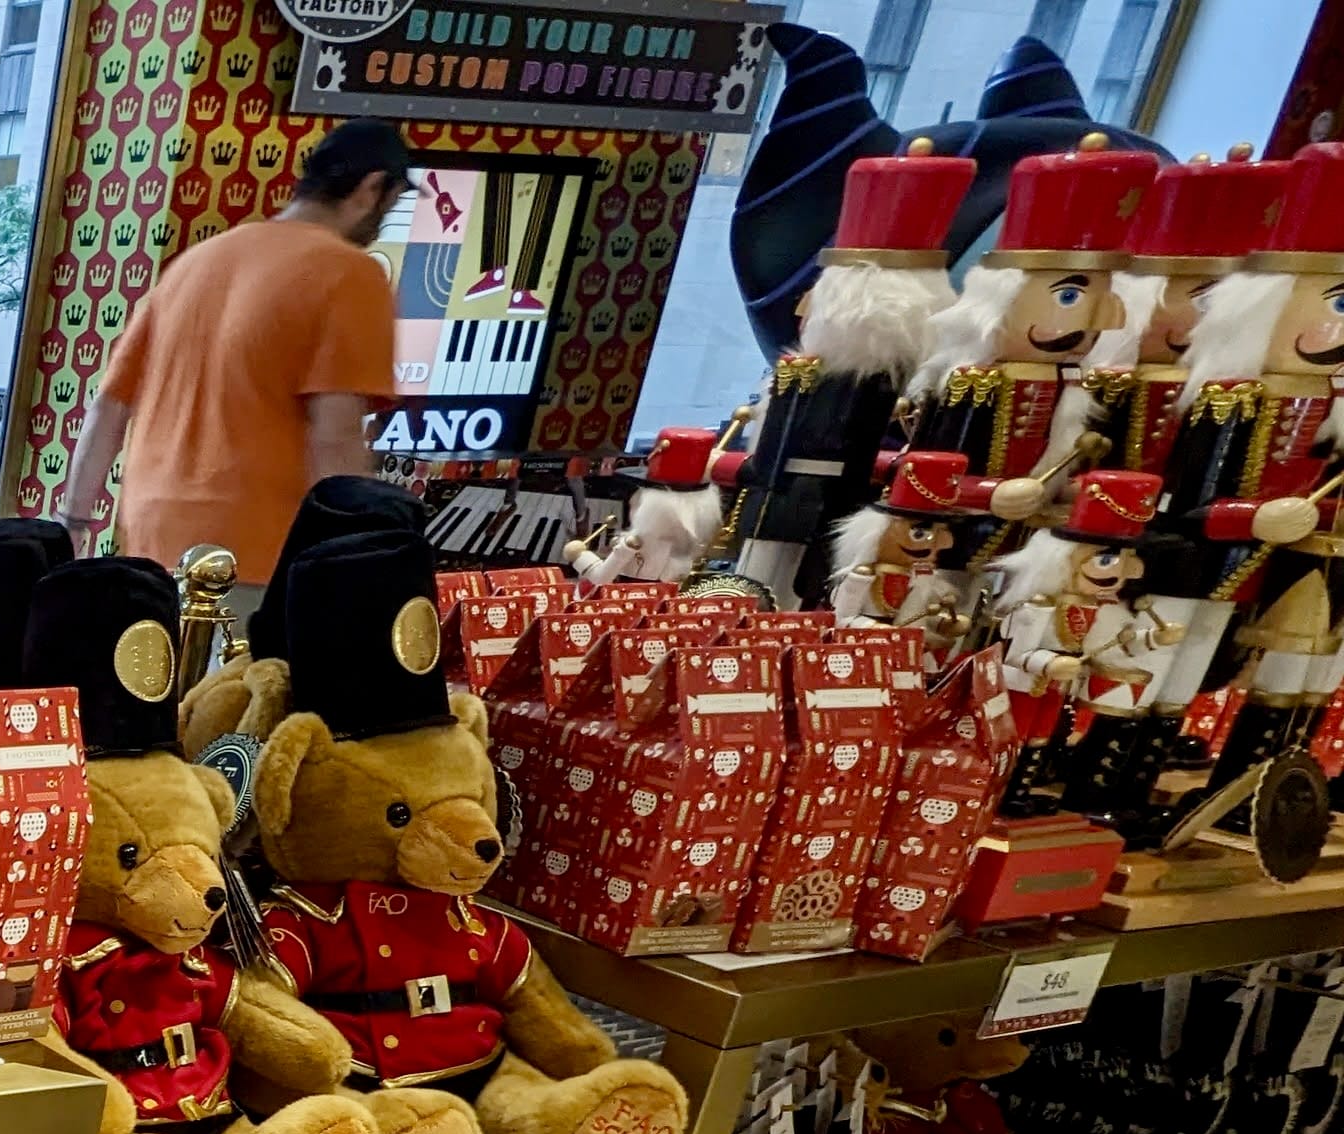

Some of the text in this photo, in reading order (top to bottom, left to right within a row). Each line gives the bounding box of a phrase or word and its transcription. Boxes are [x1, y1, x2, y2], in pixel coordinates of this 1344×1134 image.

[299, 0, 389, 18] FACTORY
[406, 9, 697, 61] BUILD YOUR OWN
[365, 50, 714, 102] CUSTOM POP FIGURE
[369, 892, 408, 915] FAO
